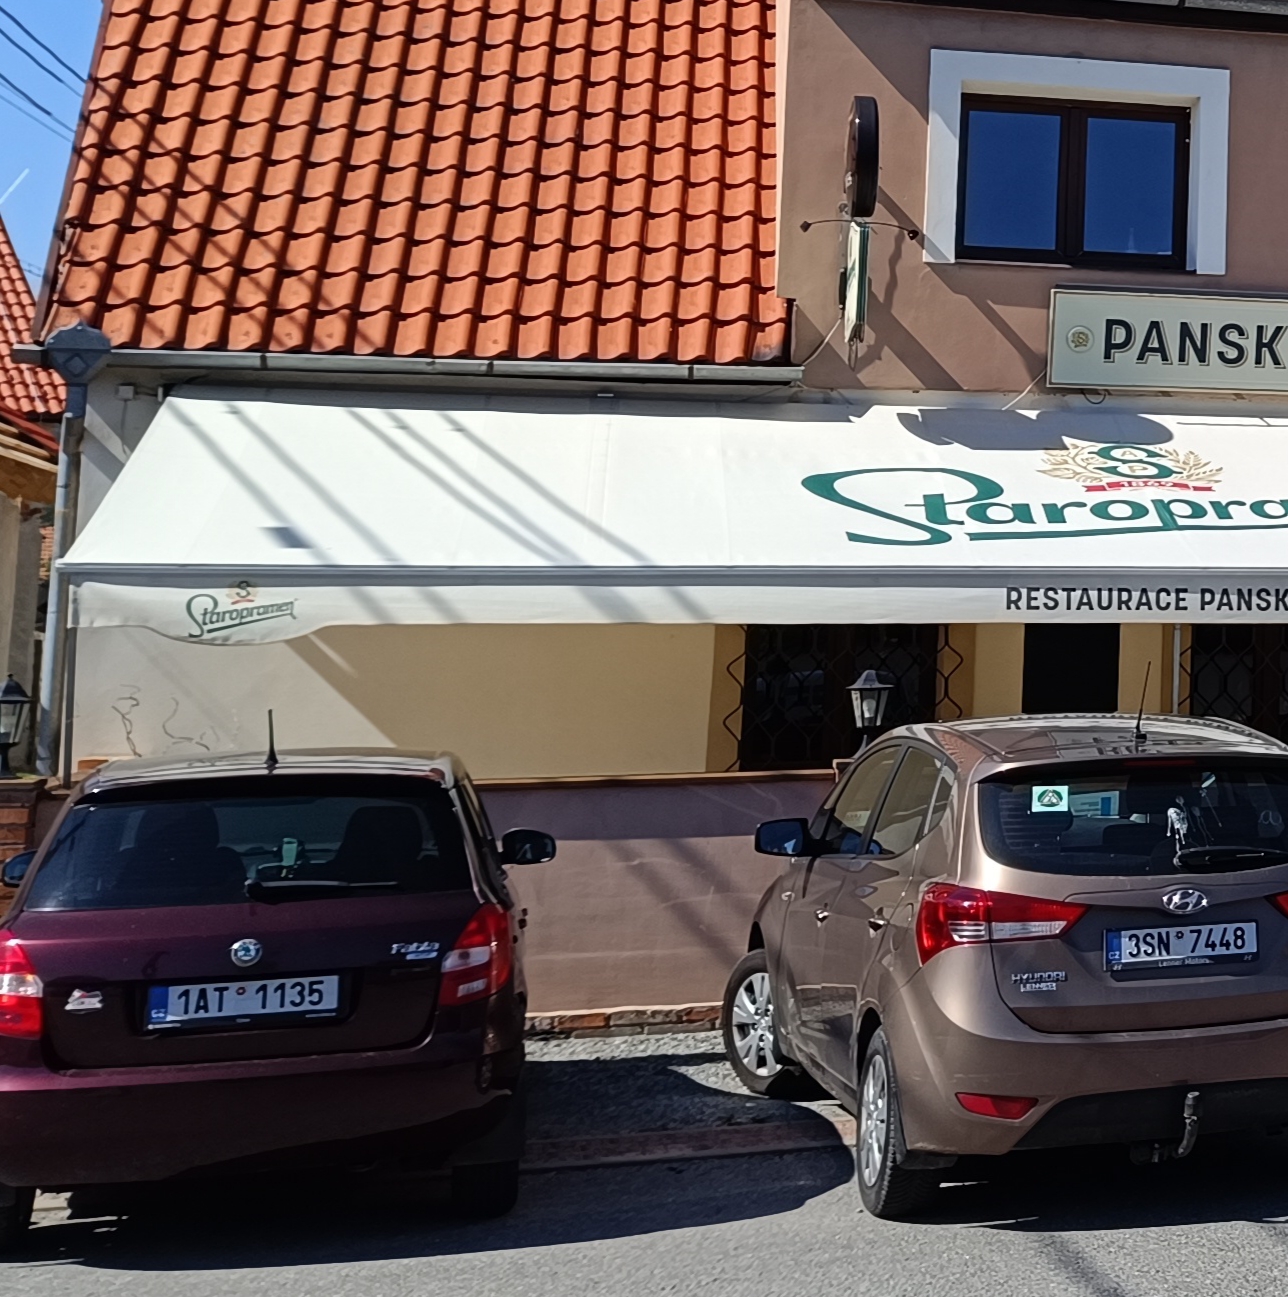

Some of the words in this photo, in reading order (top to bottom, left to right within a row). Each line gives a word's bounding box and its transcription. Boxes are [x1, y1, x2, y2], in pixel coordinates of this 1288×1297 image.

[1006, 587, 1188, 611] RESTAURACE
[186, 594, 297, 638] Staropramen
[1108, 952, 1120, 960] CZ
[1128, 933, 1170, 958] 3SN
[1189, 926, 1246, 954] 7448
[177, 986, 230, 1015] 1AT
[255, 980, 325, 1009] 1135
